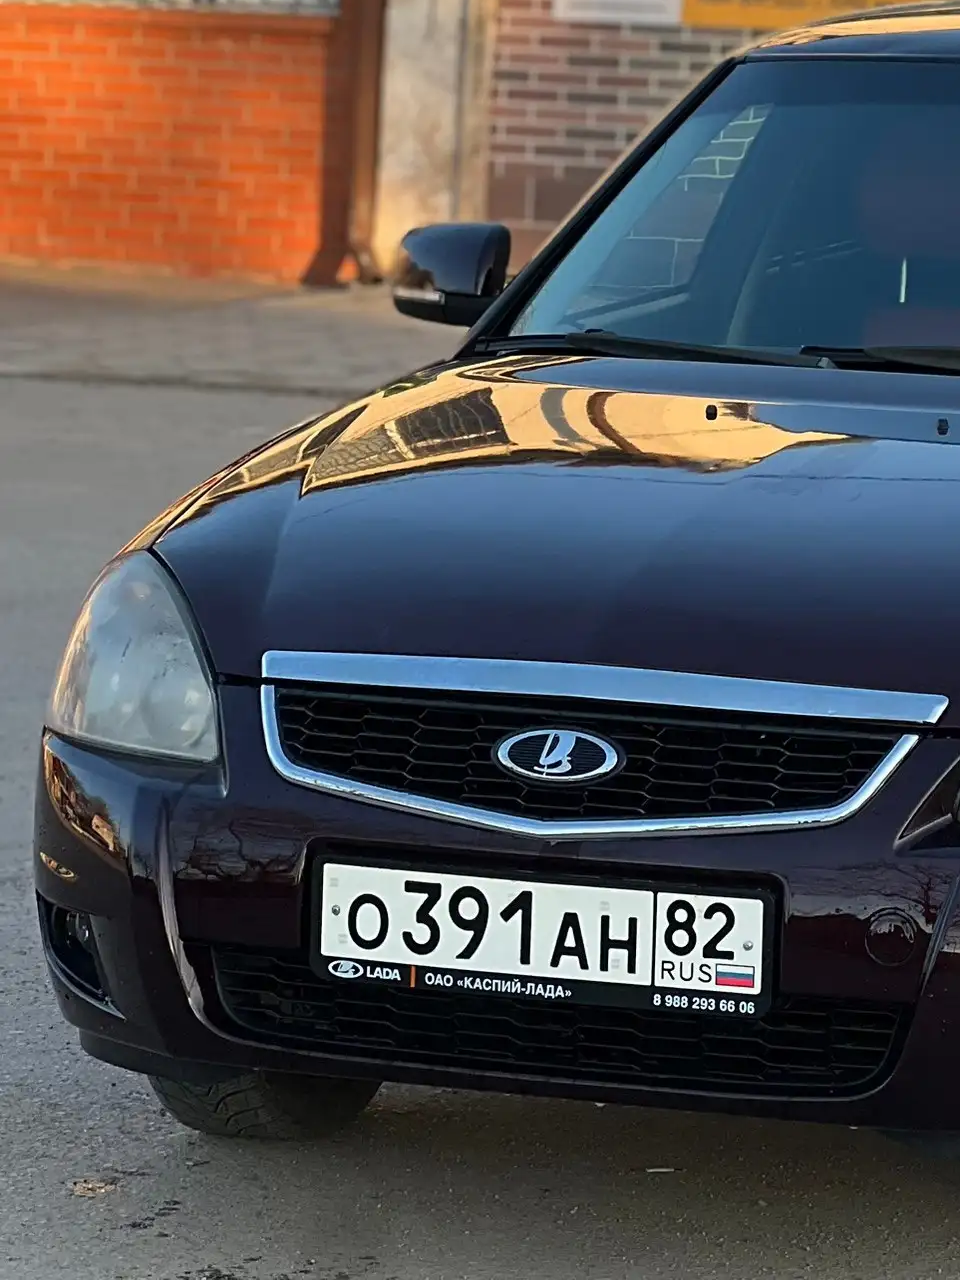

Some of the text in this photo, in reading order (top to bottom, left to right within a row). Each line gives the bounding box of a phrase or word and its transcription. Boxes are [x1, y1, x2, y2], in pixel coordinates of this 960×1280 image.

[664, 899, 736, 960] 82
[366, 965, 402, 981] LADA
[661, 960, 712, 983] RUS
[425, 972, 572, 999] ОАО «КАСПИЙ-ЛАДА»
[653, 993, 755, 1015] 8 988 293 66 06
